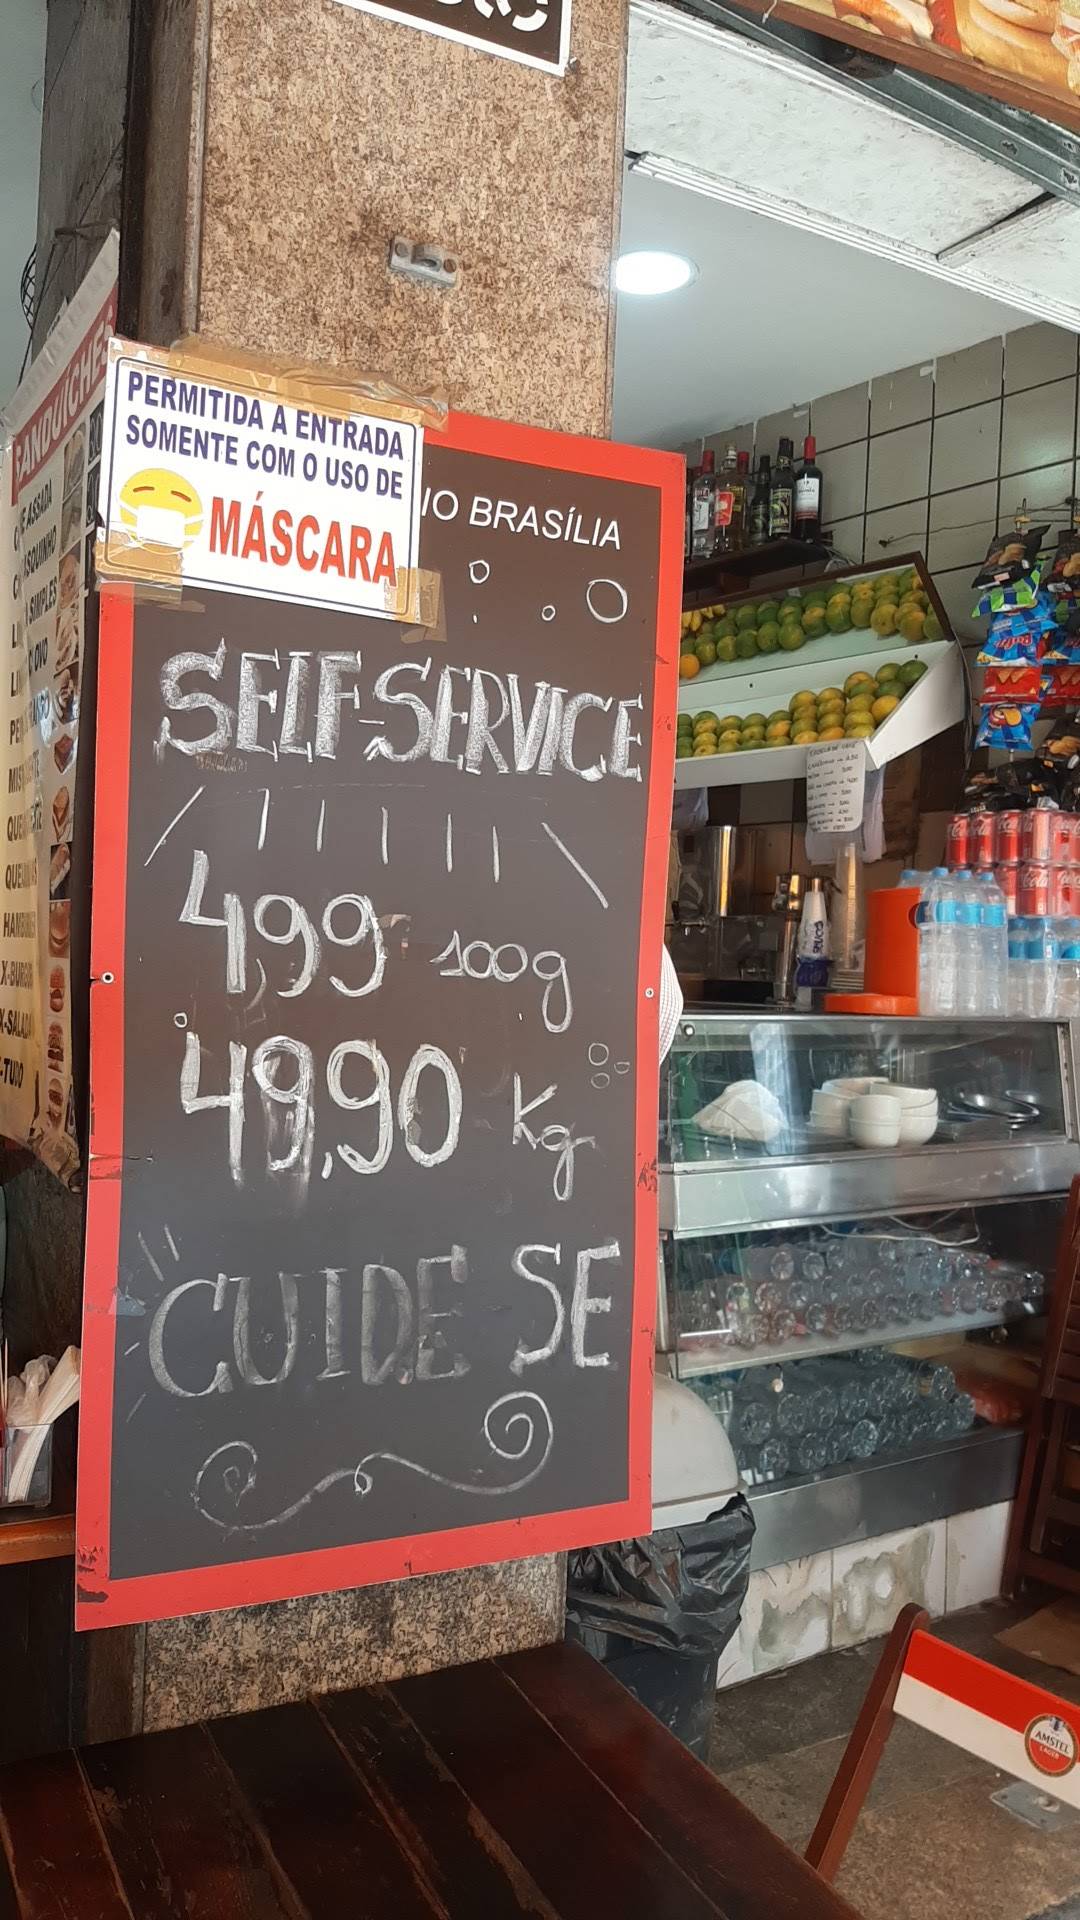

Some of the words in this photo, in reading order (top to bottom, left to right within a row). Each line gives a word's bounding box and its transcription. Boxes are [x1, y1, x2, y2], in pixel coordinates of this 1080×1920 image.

[126, 415, 238, 466] SOMENTE
[246, 441, 295, 478] COM
[303, 453, 317, 482] O
[325, 457, 369, 492] USO
[376, 468, 403, 499] DE
[128, 371, 263, 430] PERMITIDA
[271, 405, 287, 435] A
[296, 409, 404, 460] ENTRADA
[209, 491, 397, 587] MÁSCARA
[469, 496, 620, 550] BRASÍLIA
[155, 638, 644, 783] SELF-SERVICE
[179, 849, 387, 1010] 4,99
[0, 1057, 24, 1089] -TUDO
[180, 1031, 463, 1189] 49,90
[148, 1244, 471, 1398] CUIDE
[510, 1240, 620, 1377] SE
[1034, 1730, 1070, 1754] AMSTEL
